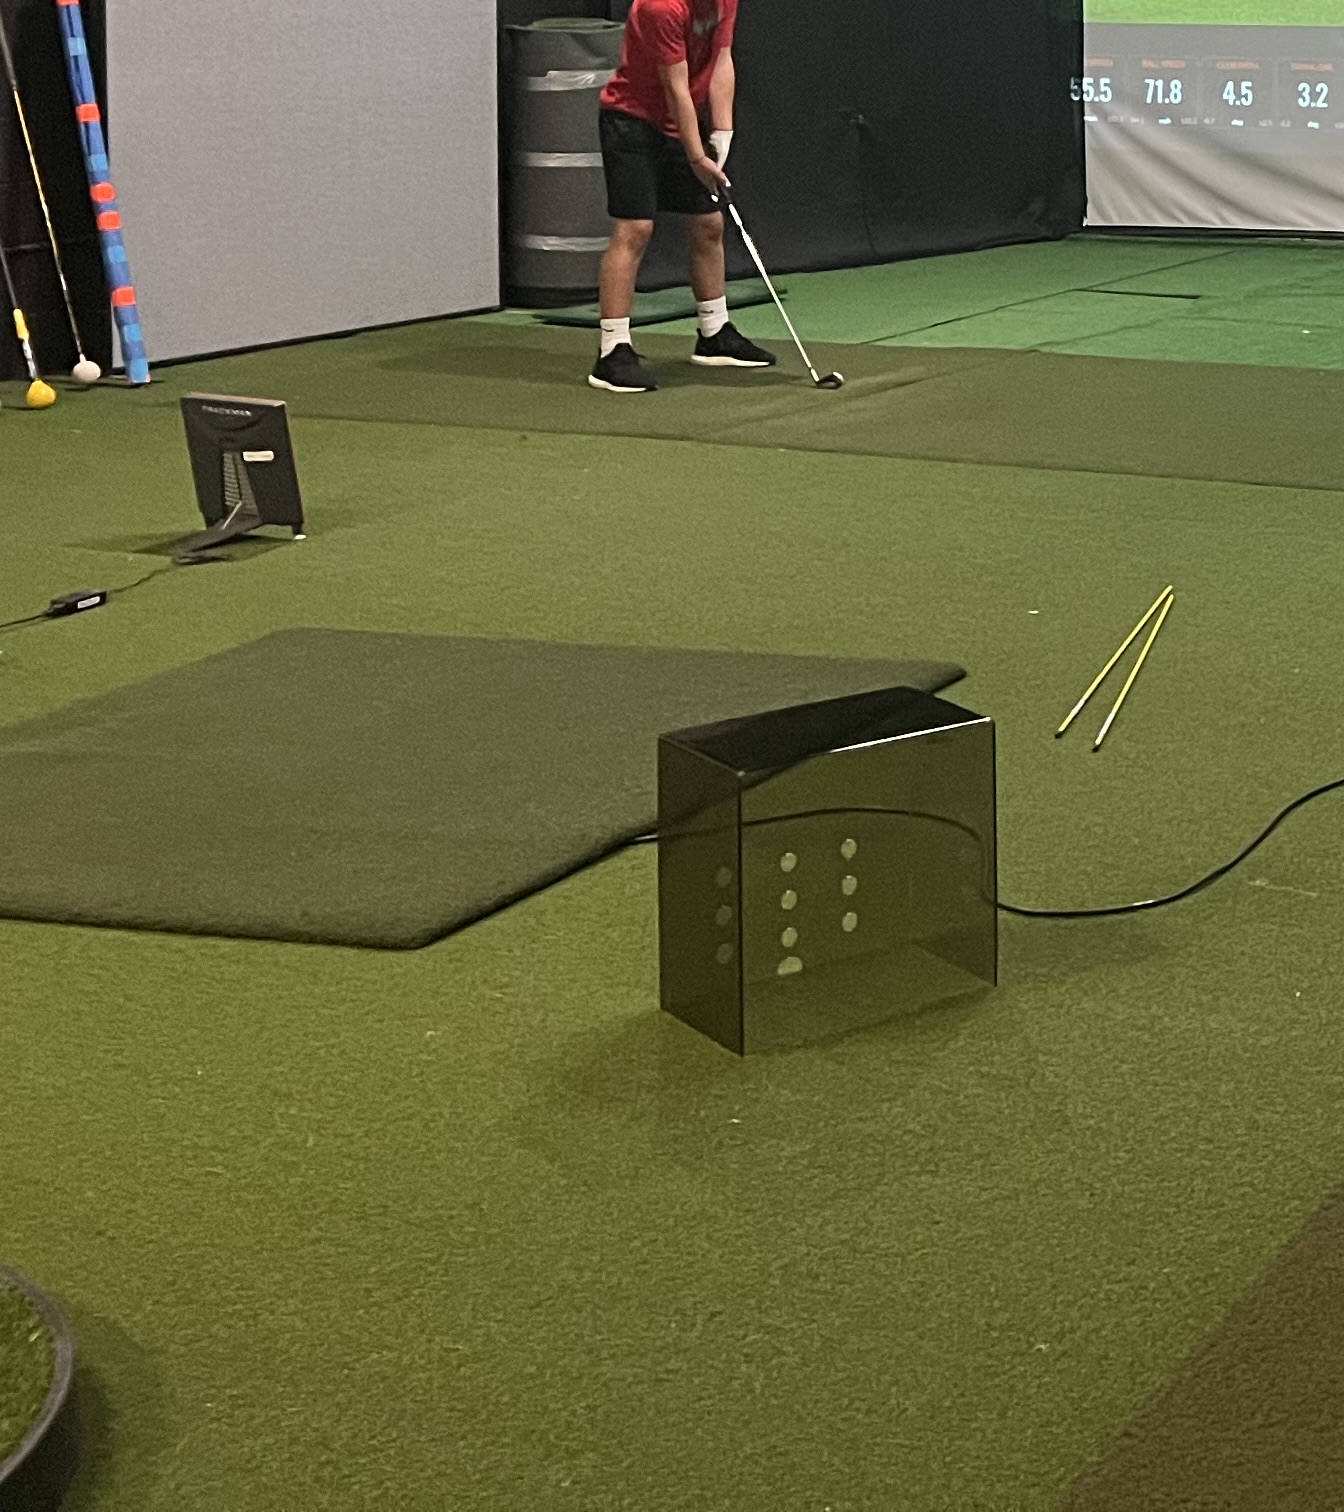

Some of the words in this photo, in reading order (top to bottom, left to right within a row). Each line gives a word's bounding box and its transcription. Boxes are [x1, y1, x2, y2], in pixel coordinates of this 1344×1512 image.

[1145, 79, 1182, 104] 71.8
[1223, 81, 1254, 106] 4.5
[1297, 82, 1328, 108] 3.2
